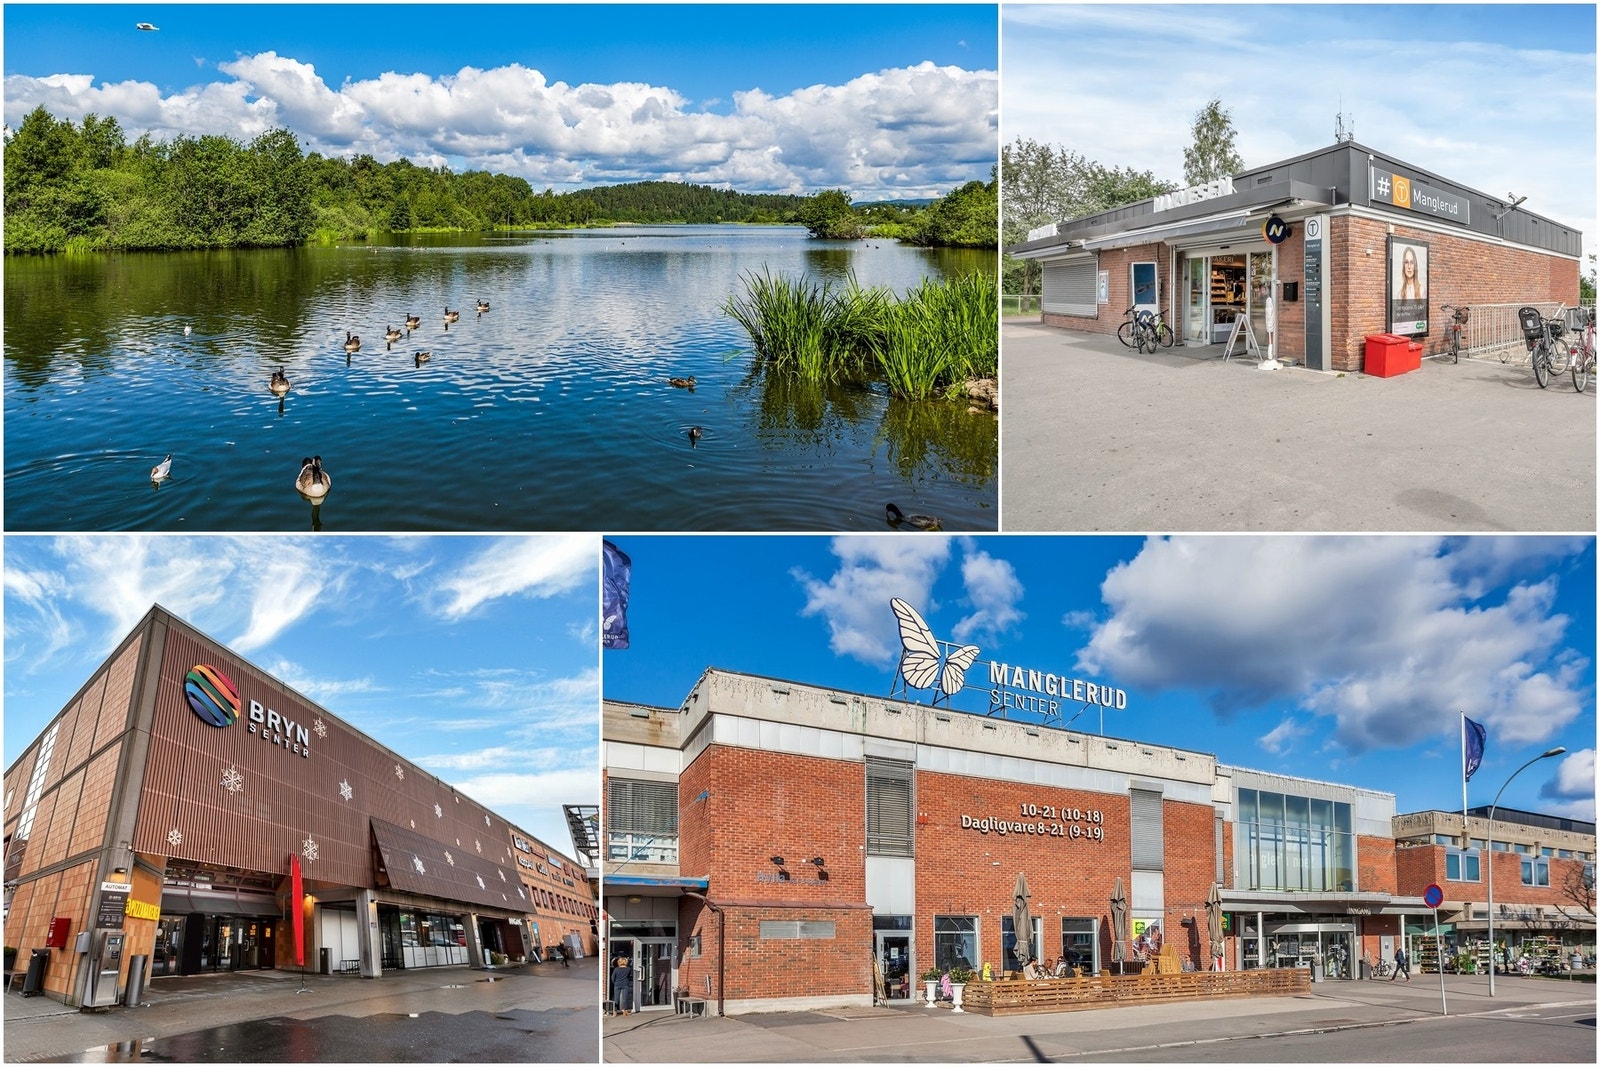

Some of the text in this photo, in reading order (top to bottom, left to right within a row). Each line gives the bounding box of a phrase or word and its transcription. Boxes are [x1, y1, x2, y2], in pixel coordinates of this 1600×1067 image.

[1413, 188, 1458, 215] Manglerud
[990, 660, 1127, 710] MANGLERUD
[990, 689, 1059, 716] SENTER
[249, 699, 309, 747] BRYN
[248, 722, 309, 758] SENTER
[961, 814, 1105, 842] Dagligvare 8-21 (9-19)
[1021, 803, 1104, 825] 10-21 (10-18)
